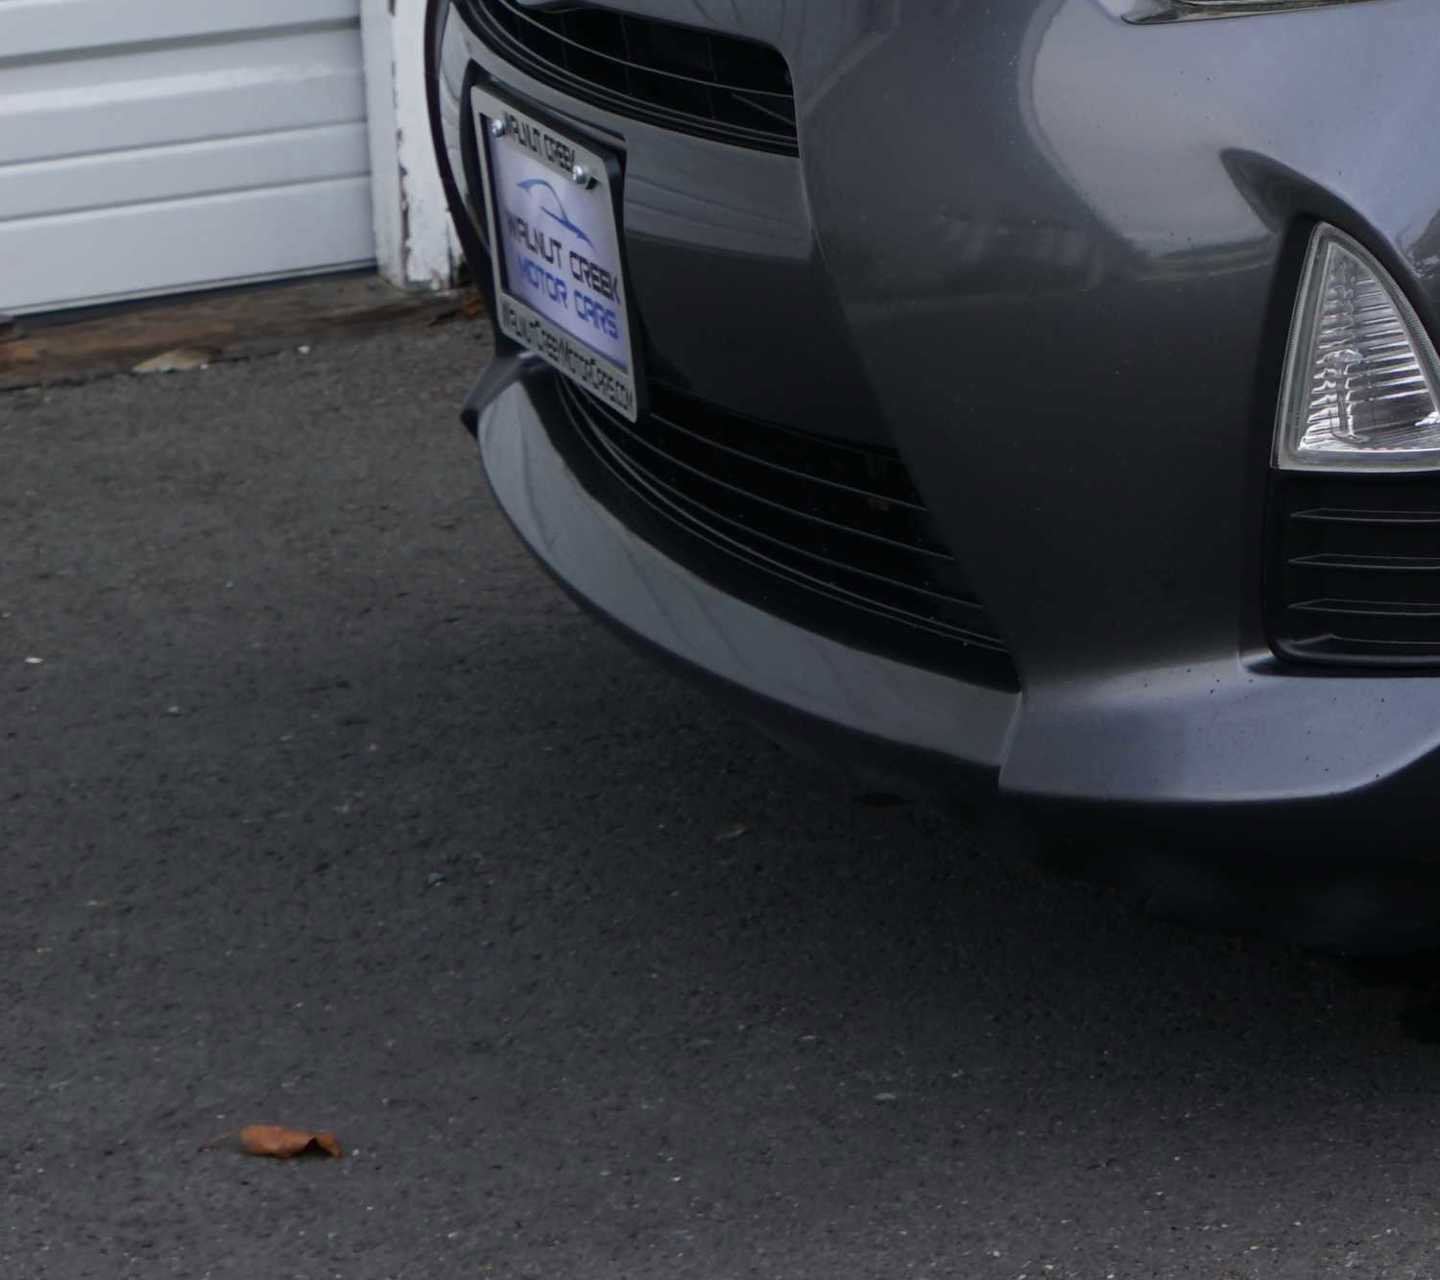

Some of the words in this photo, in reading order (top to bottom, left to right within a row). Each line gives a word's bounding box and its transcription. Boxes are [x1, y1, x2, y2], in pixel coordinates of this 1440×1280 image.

[506, 212, 562, 269] WALNUT
[569, 250, 621, 304] CREEK
[517, 256, 569, 310] MOTOR
[573, 290, 620, 340] CARS
